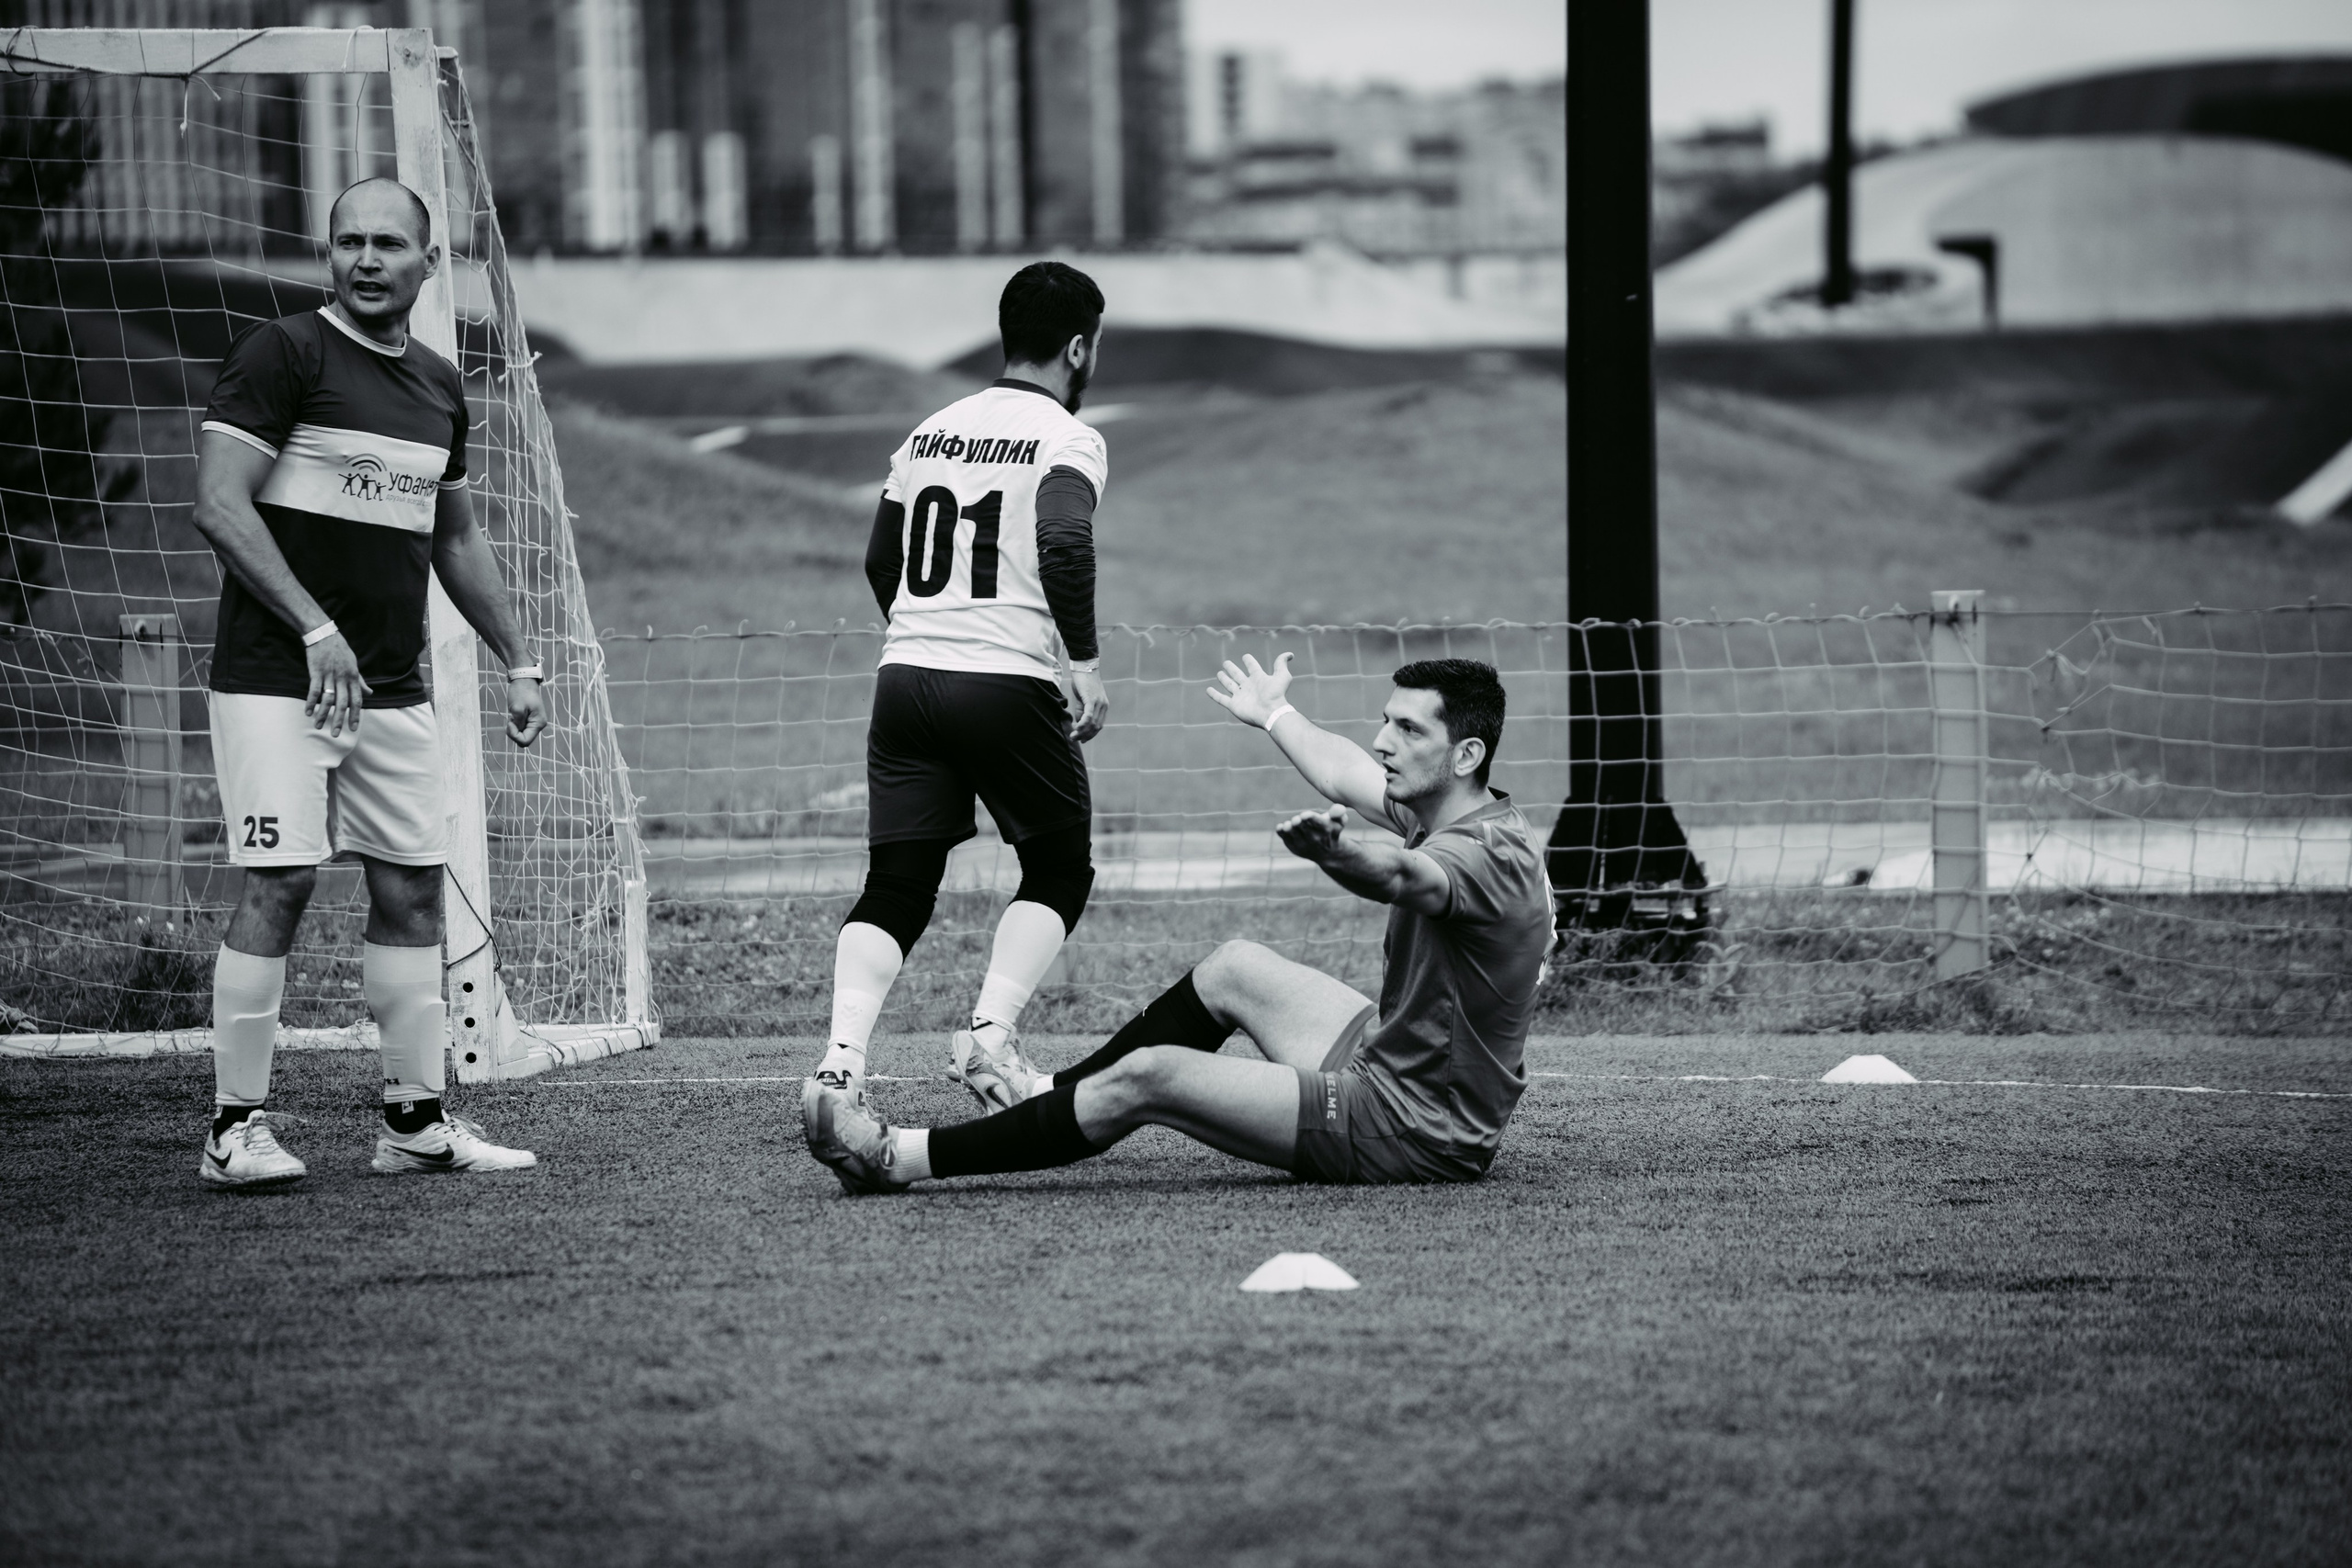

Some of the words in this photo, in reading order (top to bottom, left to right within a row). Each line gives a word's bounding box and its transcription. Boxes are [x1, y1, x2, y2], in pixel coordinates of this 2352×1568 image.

[910, 429, 1040, 465] ГАЙФУЛЛИН
[907, 485, 1003, 599] 01
[243, 815, 279, 849] 25
